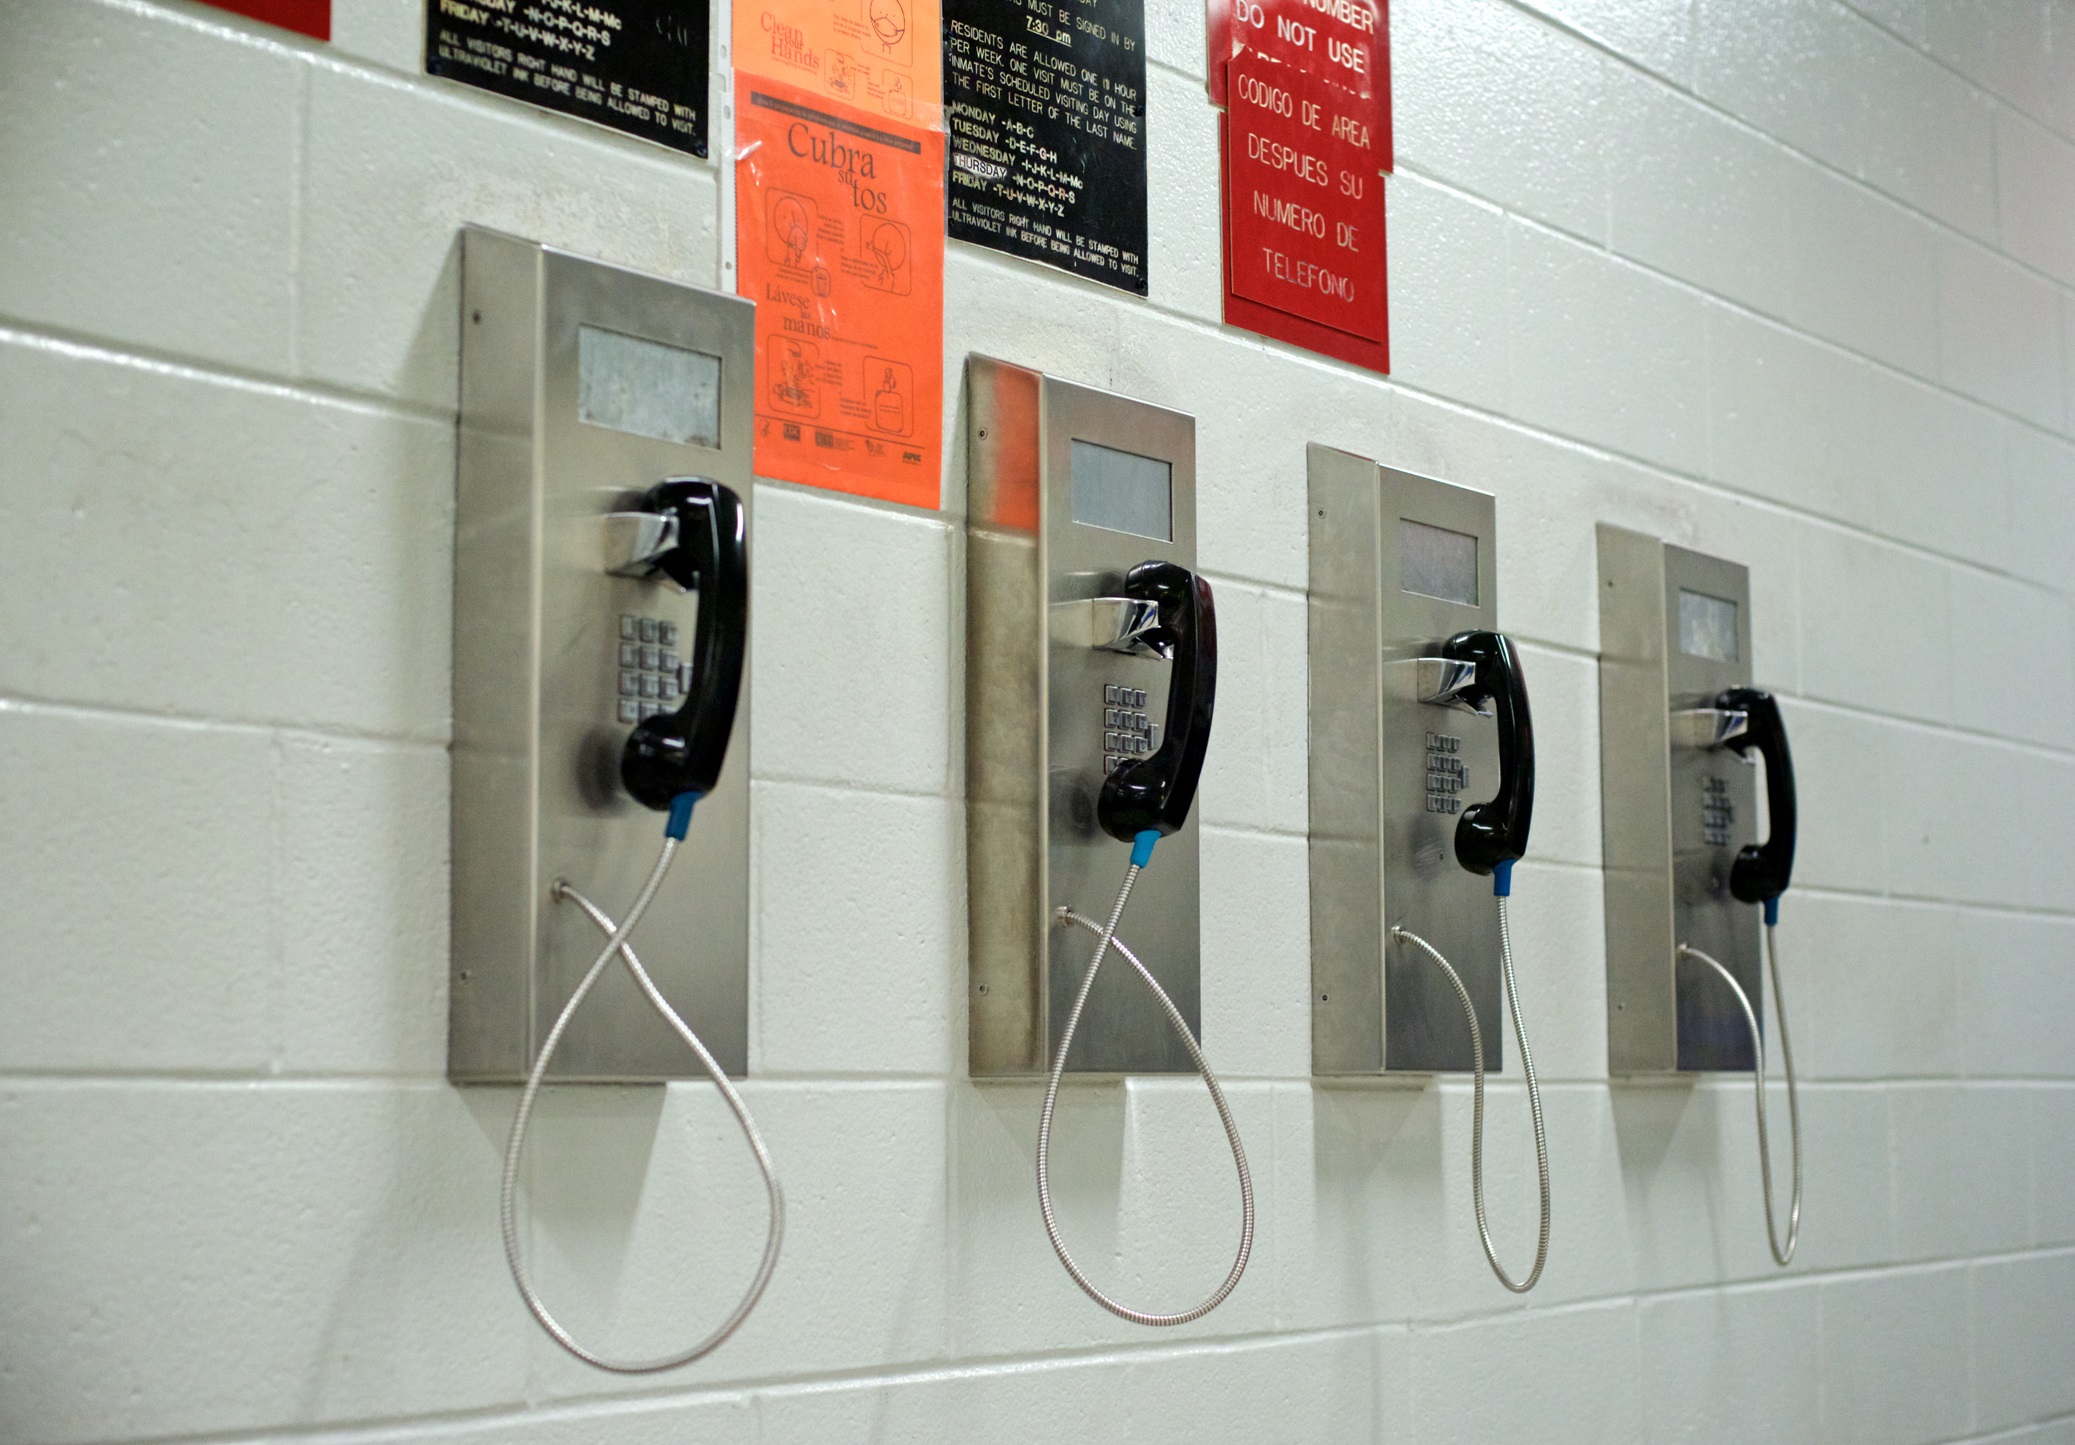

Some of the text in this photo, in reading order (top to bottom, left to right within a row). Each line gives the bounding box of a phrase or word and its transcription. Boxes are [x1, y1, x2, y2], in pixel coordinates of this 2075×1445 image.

[440, 0, 490, 26] FRIDAY
[760, 12, 804, 42] Clean
[1026, 15, 1072, 46] 7:30 pm
[1027, 0, 1136, 51] MUST BE SIGNED IN BY
[1236, 0, 1265, 29] DO
[1277, 15, 1317, 52] NOT
[1328, 37, 1365, 74] USE
[771, 35, 820, 69] Hands
[785, 36, 804, 51] your
[950, 20, 1004, 50] RESIDENTS
[1009, 42, 1028, 59] ARE
[1033, 53, 1077, 77] ALLOWED
[1081, 68, 1098, 86] ONE
[1114, 82, 1137, 101] HOUR
[439, 44, 507, 76] ULTRAVIOLET
[512, 66, 530, 82] INK
[533, 72, 570, 96] BEFORE
[575, 86, 602, 105] BEING
[607, 97, 650, 120] ALLOWED
[654, 112, 667, 126] TO
[440, 28, 460, 47] ALL
[466, 37, 513, 63] VISITORS
[551, 63, 577, 82] HAND
[582, 73, 605, 91] WILL
[610, 82, 622, 97] BE
[627, 87, 669, 112] STAMPED
[673, 103, 696, 121] WITH
[950, 37, 970, 55] PER
[1009, 58, 1028, 76] ONE
[1033, 68, 1055, 85] VISIT
[1060, 77, 1084, 96] MUST
[1088, 88, 1100, 104] BE
[1104, 95, 1116, 111] ON
[1121, 100, 1136, 117] THE
[951, 54, 1137, 134] INMATE'S SCHEDULED VISITING DAY USING
[952, 70, 971, 90] THE
[975, 79, 1002, 101] FIRST
[1008, 91, 1044, 116] LETTER
[1048, 105, 1060, 120] OF
[1065, 112, 1082, 130] THE
[1086, 121, 1108, 141] LAST
[952, 100, 996, 125] MONDAY
[1238, 74, 1371, 150] CODIGO DE AREA
[788, 122, 876, 180] Cubra
[952, 117, 1058, 164] TUESDAY -D-E-F-G-H
[952, 135, 1016, 168] WEDNESDAY
[953, 153, 1008, 180] THURSDAY
[1248, 133, 1363, 200] DESPUES SU
[838, 169, 855, 187] su
[852, 180, 887, 214] tos
[952, 170, 988, 192] FRIDAY
[952, 196, 1139, 265] ALL VISITORS RIGHT HAND WILL BE STAMPED WITH
[952, 210, 1002, 234] ULTRAVIOLET
[1005, 226, 1017, 239] INK
[1021, 229, 1048, 249] BEFORE
[1051, 239, 1071, 256] BEING
[1073, 246, 1105, 267] ALLOWED
[1108, 256, 1118, 270] TO
[1253, 190, 1360, 252] NUMERO DE
[1262, 247, 1355, 303] TELEFONO
[783, 316, 831, 340] manos
